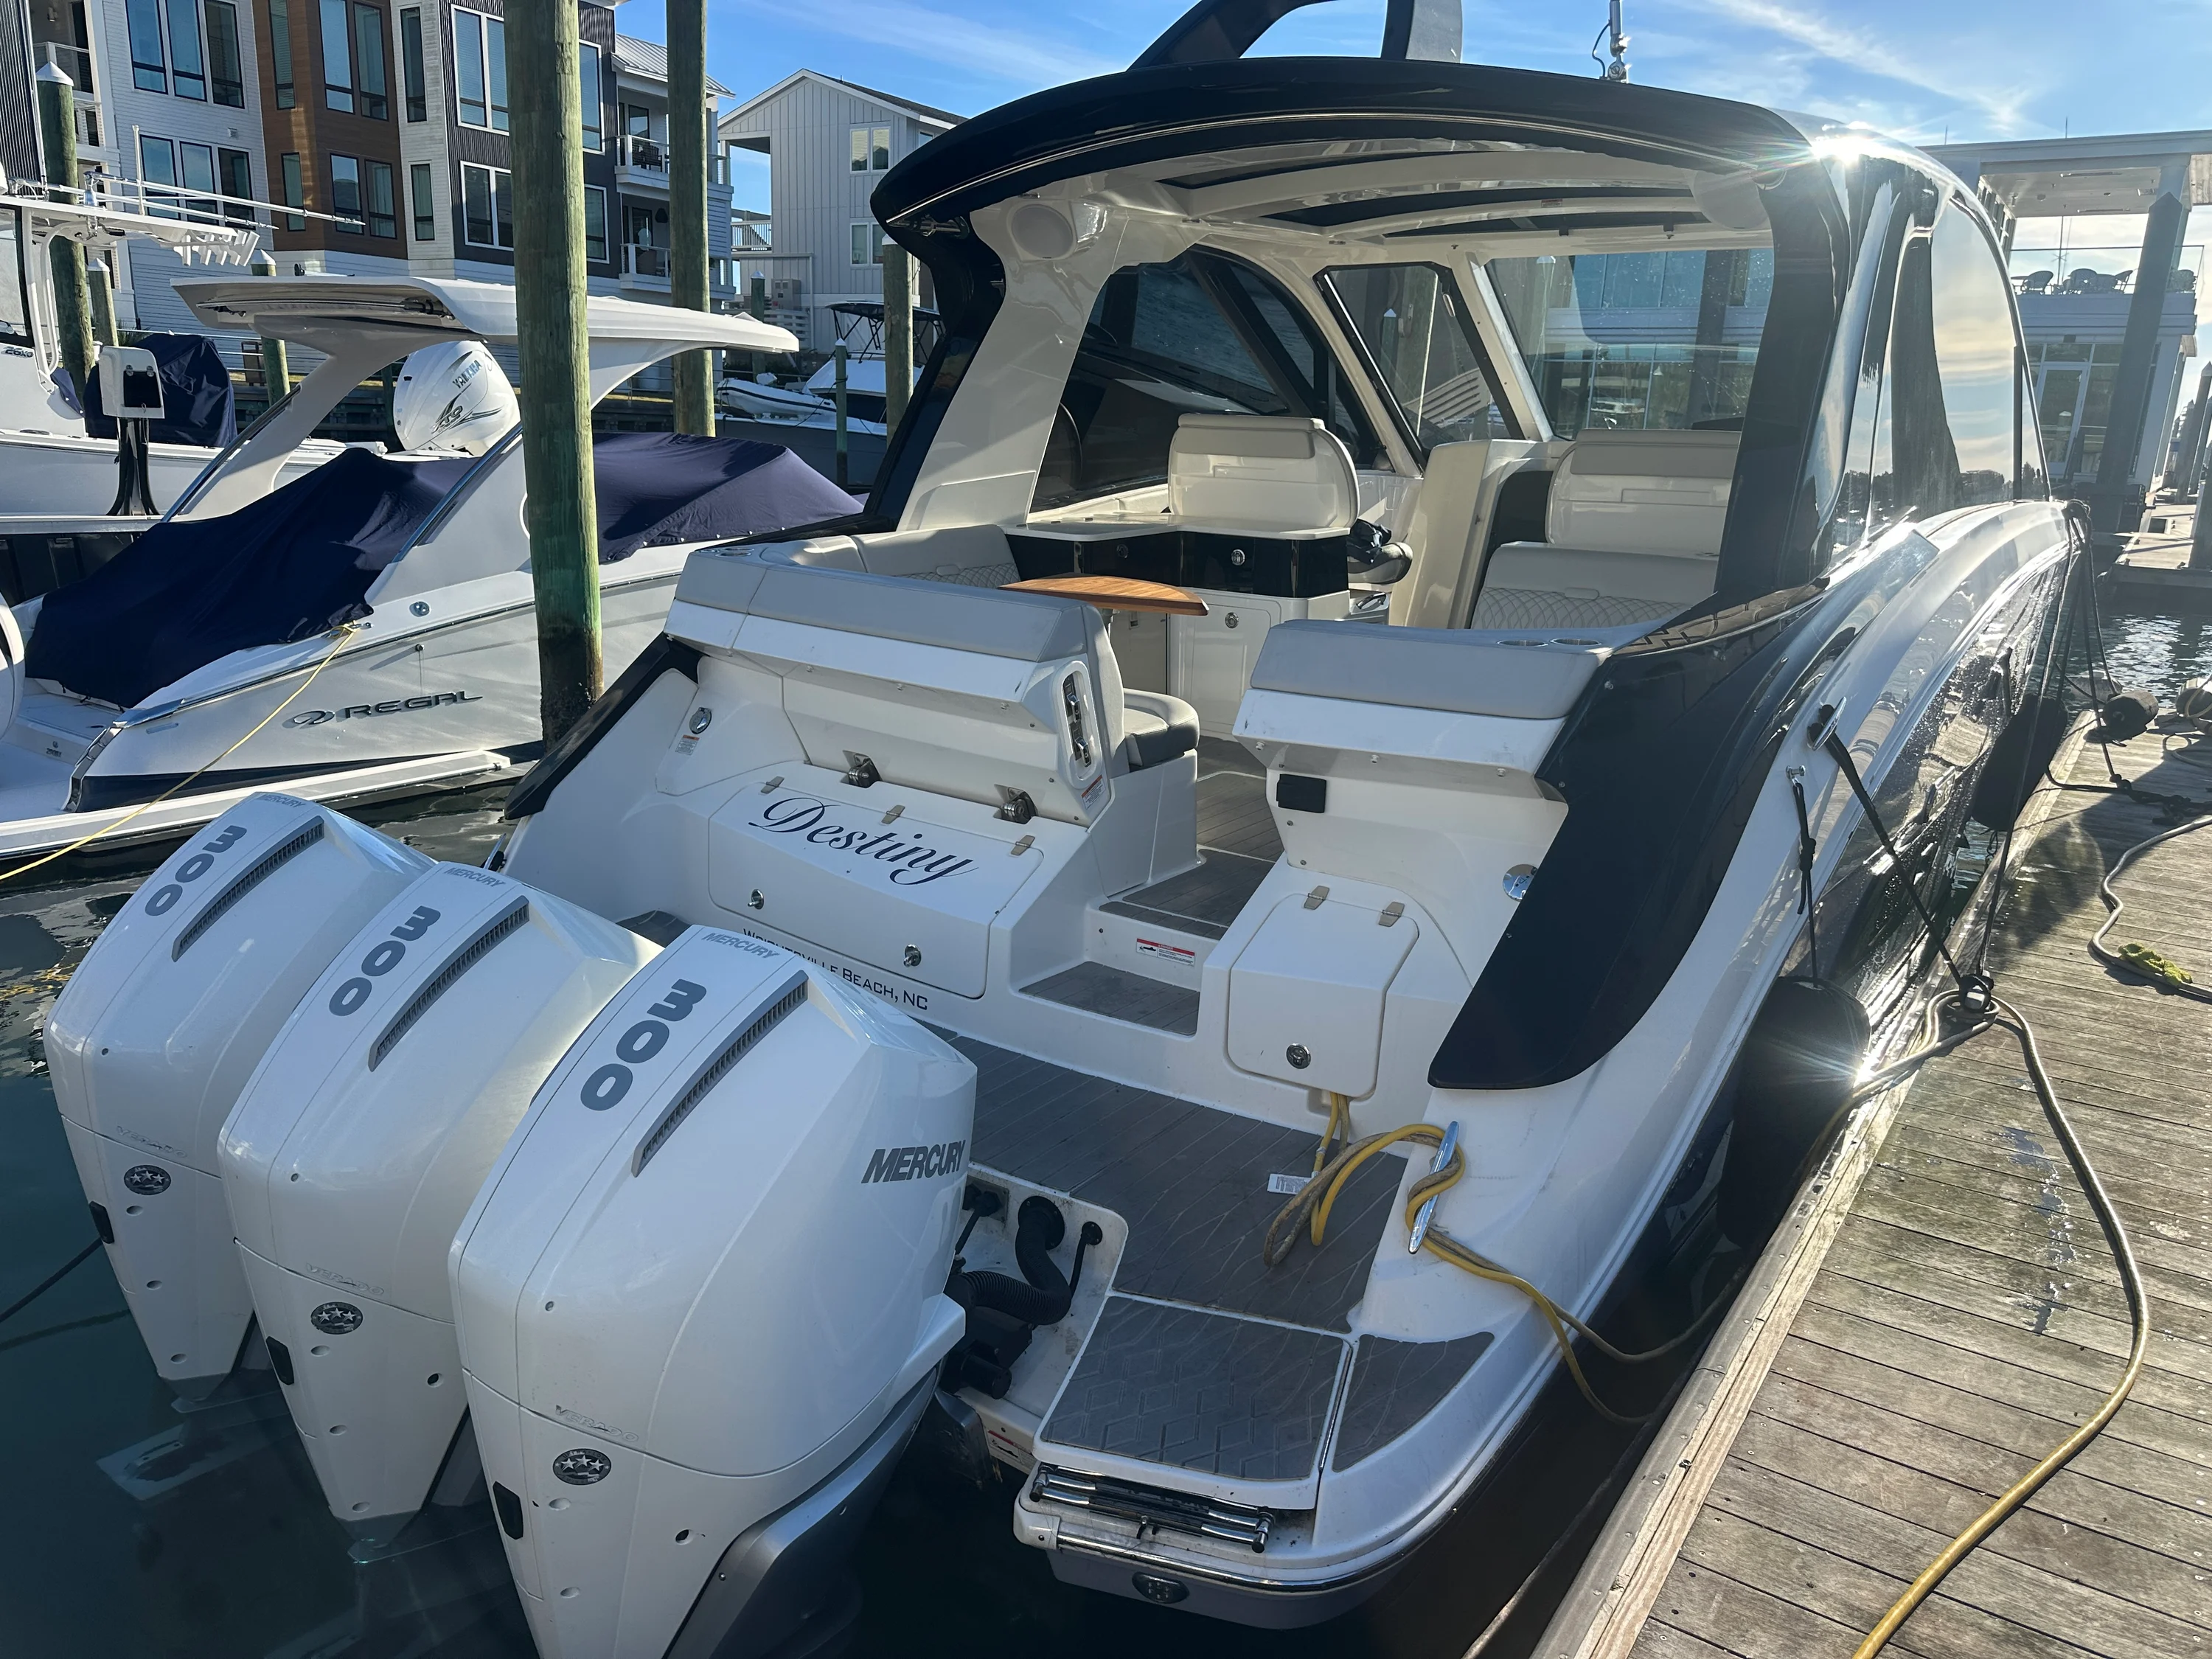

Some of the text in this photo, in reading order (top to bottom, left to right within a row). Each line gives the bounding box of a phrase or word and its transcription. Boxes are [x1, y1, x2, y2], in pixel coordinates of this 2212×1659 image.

[452, 359, 483, 389] YAMAHA
[344, 690, 484, 719] REGAL
[748, 796, 980, 886] Destiny
[145, 824, 248, 917] 300
[444, 867, 507, 888] MERCURY
[329, 905, 442, 1017] 300
[701, 932, 780, 959] MERCURY
[903, 990, 928, 1011] NC
[580, 978, 707, 1111] 300
[860, 1139, 967, 1184] MERCURY
[555, 1404, 639, 1443] VERADO
